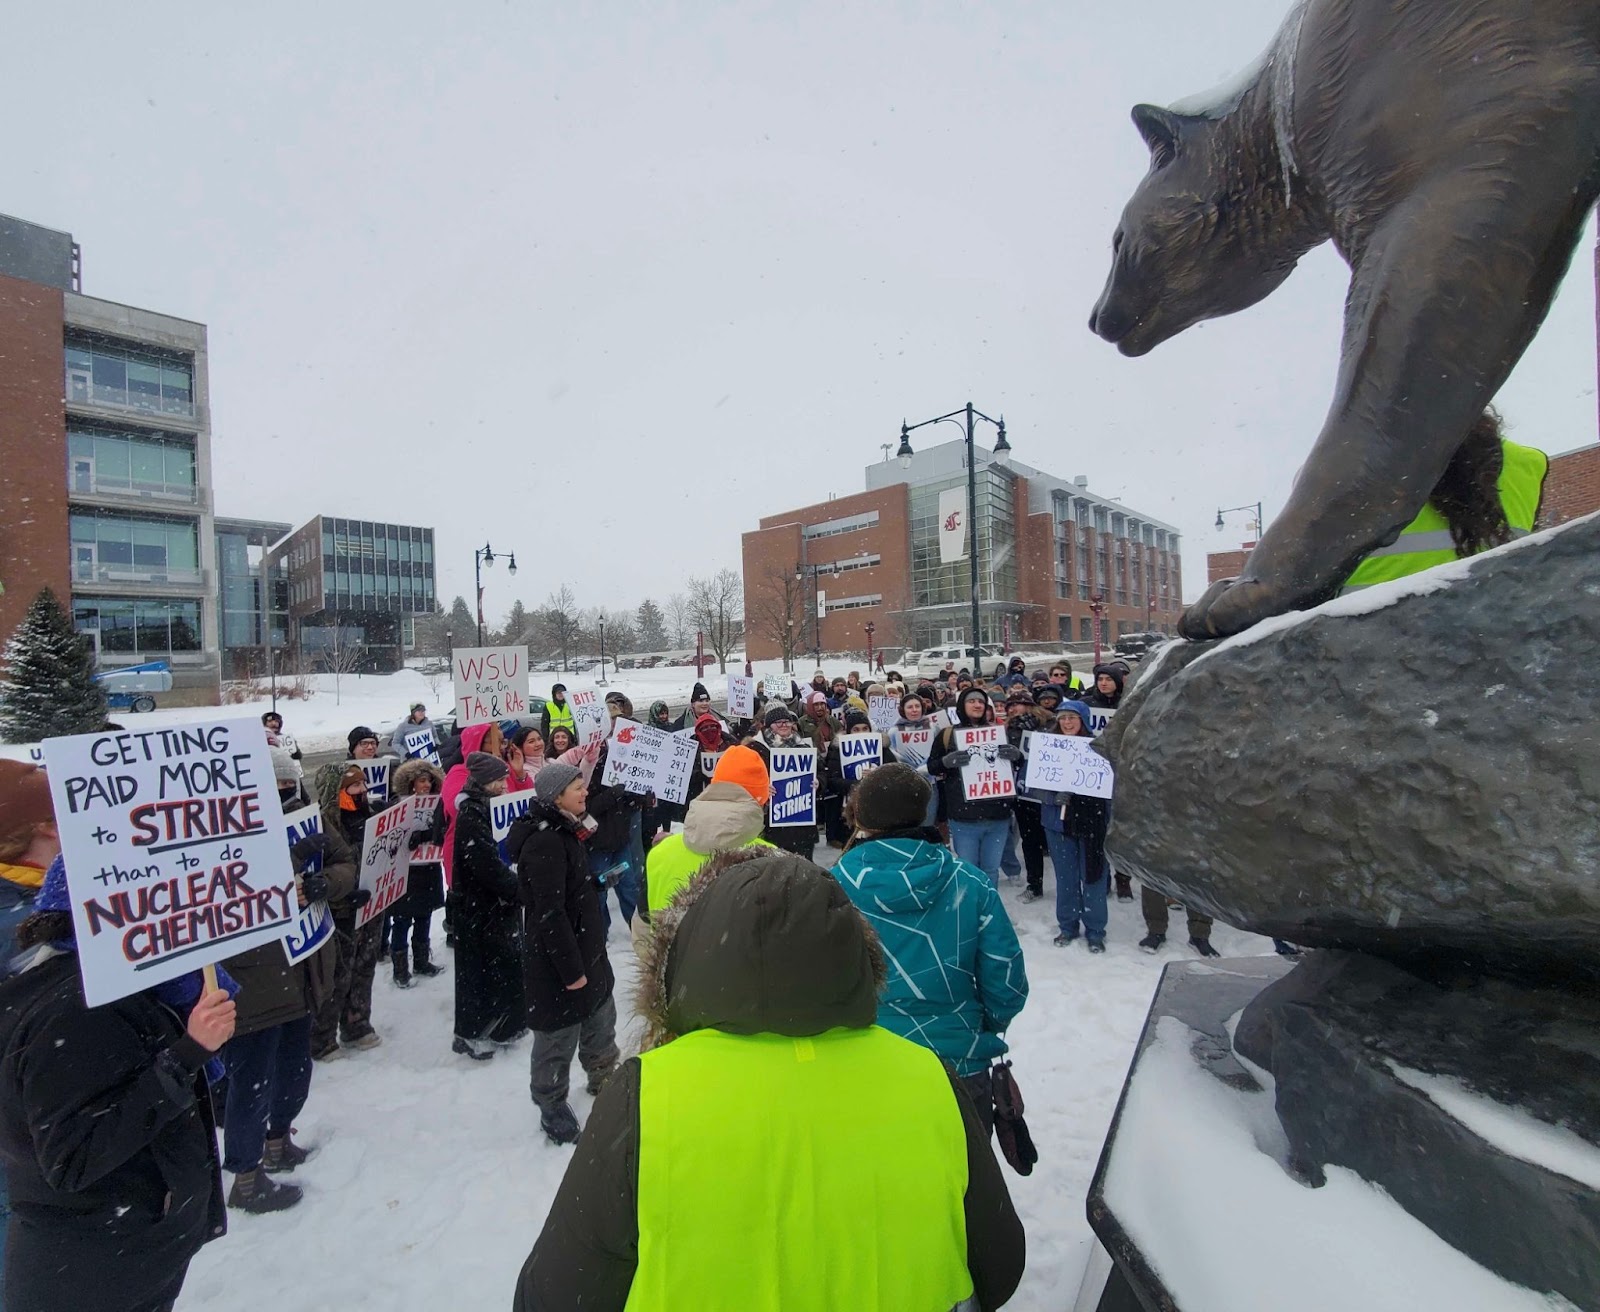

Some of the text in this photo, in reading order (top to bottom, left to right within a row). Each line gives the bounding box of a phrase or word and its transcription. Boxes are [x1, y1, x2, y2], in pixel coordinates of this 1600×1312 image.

[459, 653, 518, 682] WSU
[476, 681, 510, 694] Runs On
[460, 692, 524, 721] TAs & RAs
[573, 691, 596, 705] BITE
[91, 726, 229, 766] GETTING
[408, 733, 430, 747] UAW
[589, 730, 602, 742] THE
[901, 732, 928, 744] WSU
[965, 729, 997, 744] BITE
[673, 746, 690, 759] 50:1
[841, 739, 879, 757] UAW
[670, 760, 687, 773] 29:1
[773, 754, 813, 772] UAW
[65, 754, 257, 813] PAID MORE
[666, 774, 683, 787] 36:1
[976, 771, 998, 782] THE
[1035, 767, 1105, 790] ME DO!
[663, 787, 682, 802] 45:1
[785, 779, 801, 799] ON
[969, 780, 1012, 797] HAND
[773, 794, 812, 821] STRIKE
[91, 793, 265, 847] to STRIKE
[375, 804, 407, 837] BITE
[286, 815, 317, 848] AW
[93, 844, 243, 887] than to do
[376, 868, 396, 893] THE
[83, 861, 254, 936] NUCLEAR
[361, 877, 405, 923] HAND
[122, 881, 295, 962] CHEMISTRY
